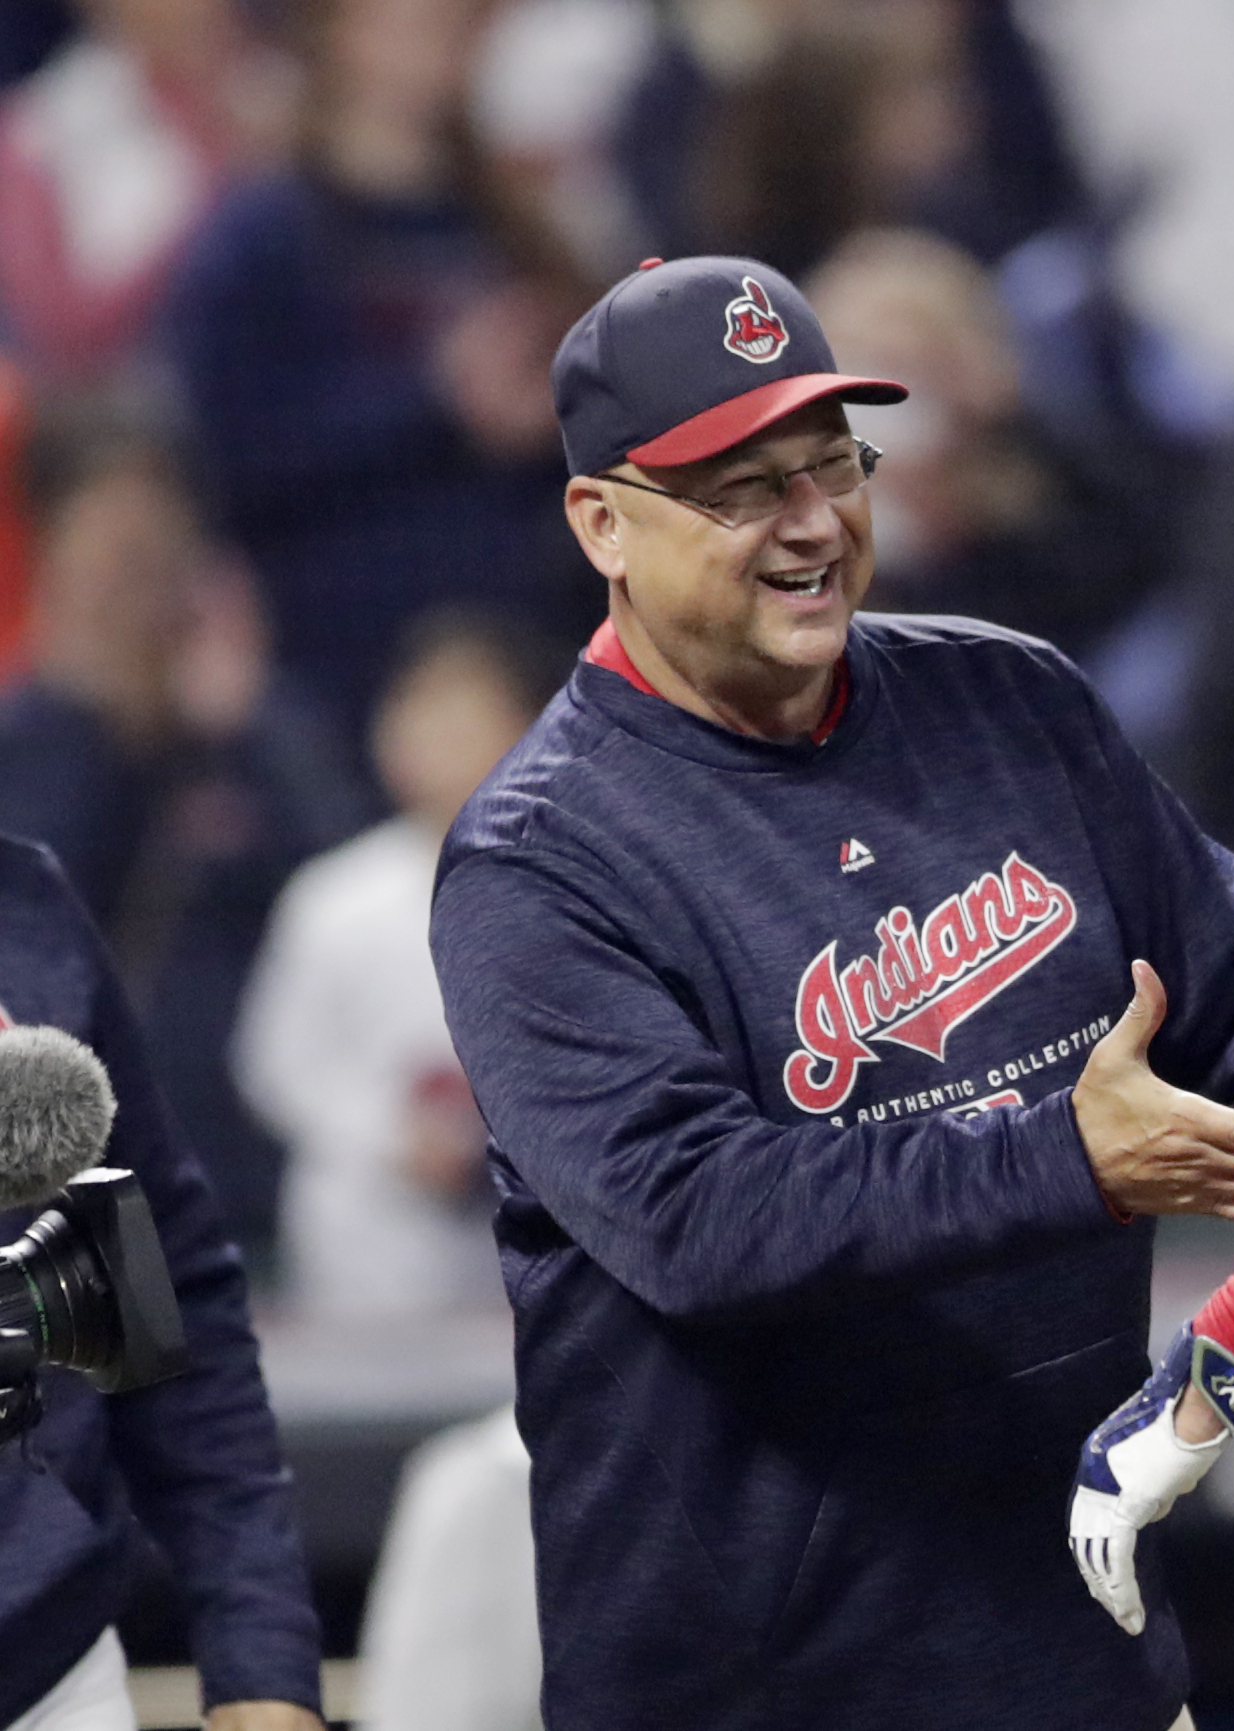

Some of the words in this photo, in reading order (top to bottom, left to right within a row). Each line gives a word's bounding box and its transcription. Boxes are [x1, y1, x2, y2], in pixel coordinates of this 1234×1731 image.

[784, 850, 1077, 1114] Indians
[857, 1079, 975, 1124] AUTHENTIC
[987, 1015, 1110, 1087] COLLECTION
